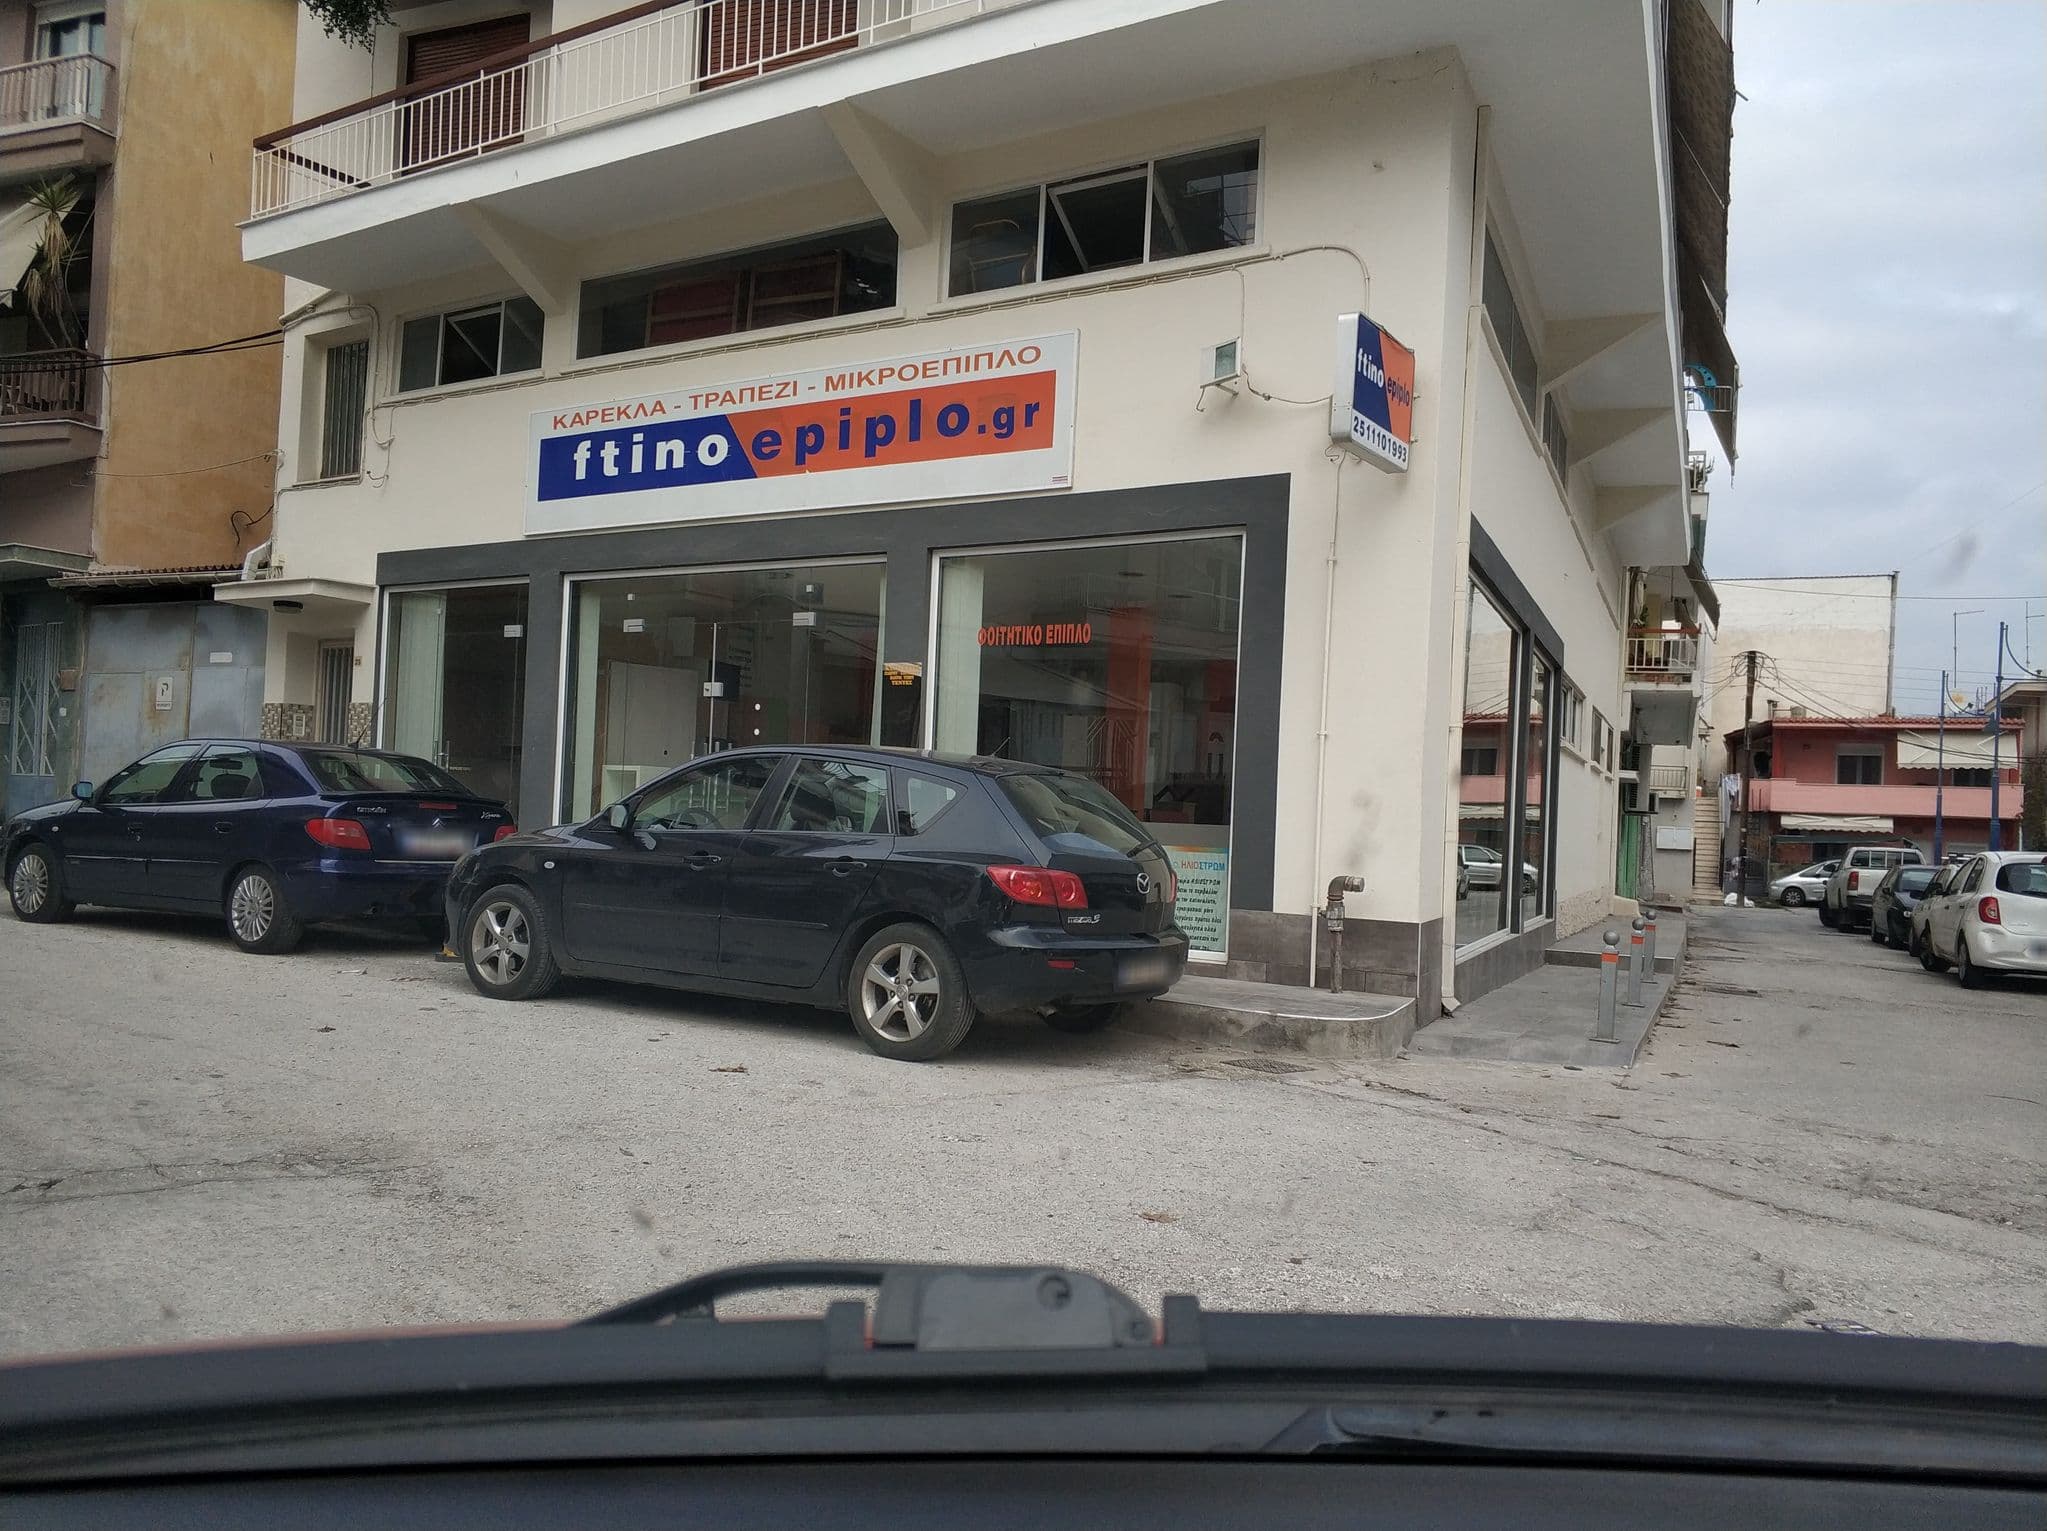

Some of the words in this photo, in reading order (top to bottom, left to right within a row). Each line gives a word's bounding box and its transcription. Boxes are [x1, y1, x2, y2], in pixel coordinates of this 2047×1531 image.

[553, 400, 666, 430] ΚΑΡΕΚΛΑ
[689, 381, 798, 411] ΤΡΑΠΕΖΙ
[824, 345, 1042, 393] ΜΙΚΡΟΕΠΙΠΛΟ
[1357, 348, 1384, 389] ftino
[1387, 376, 1410, 407] epiplo
[573, 433, 729, 480] ftino
[751, 398, 1040, 466] epiplo.gr
[1353, 416, 1407, 463] 2511101993
[977, 625, 1042, 646] ΦΟΙΤΗΤΙΚΟ
[1046, 623, 1091, 644] ΕΠΙΠΛΟ
